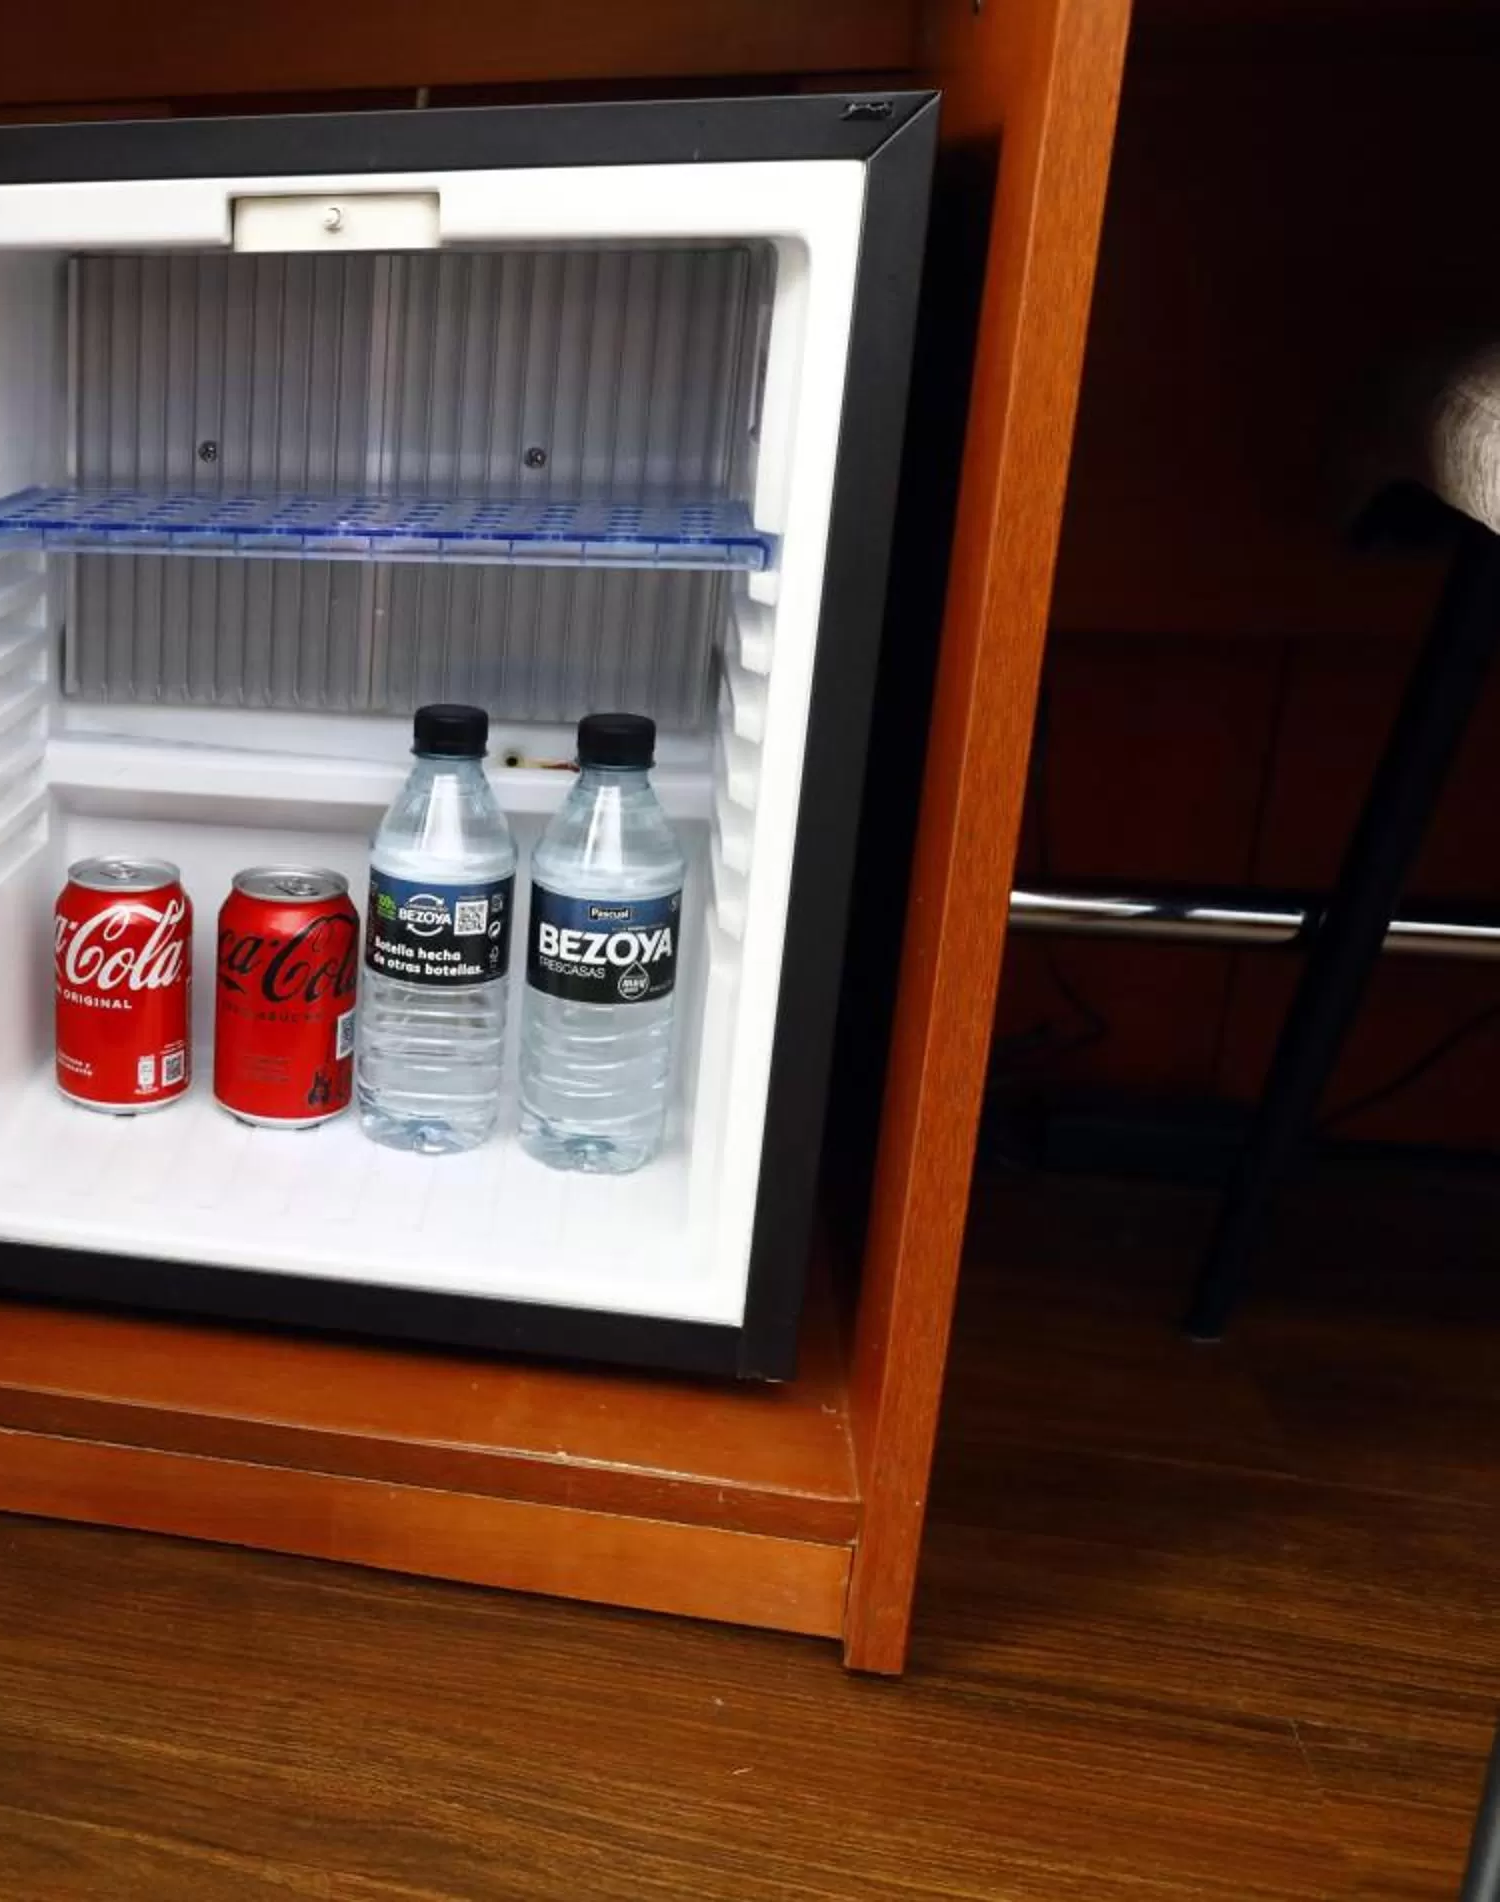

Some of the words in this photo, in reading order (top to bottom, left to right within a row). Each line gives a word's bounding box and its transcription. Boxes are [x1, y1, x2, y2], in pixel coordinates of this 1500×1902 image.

[399, 907, 452, 925] BEZOYA
[591, 907, 630, 919] Pascual
[375, 935, 414, 957] botella
[417, 947, 461, 961] hecha
[539, 921, 672, 967] BEZOYA
[387, 958, 421, 974] otras
[63, 988, 132, 1010] ORIGINAL
